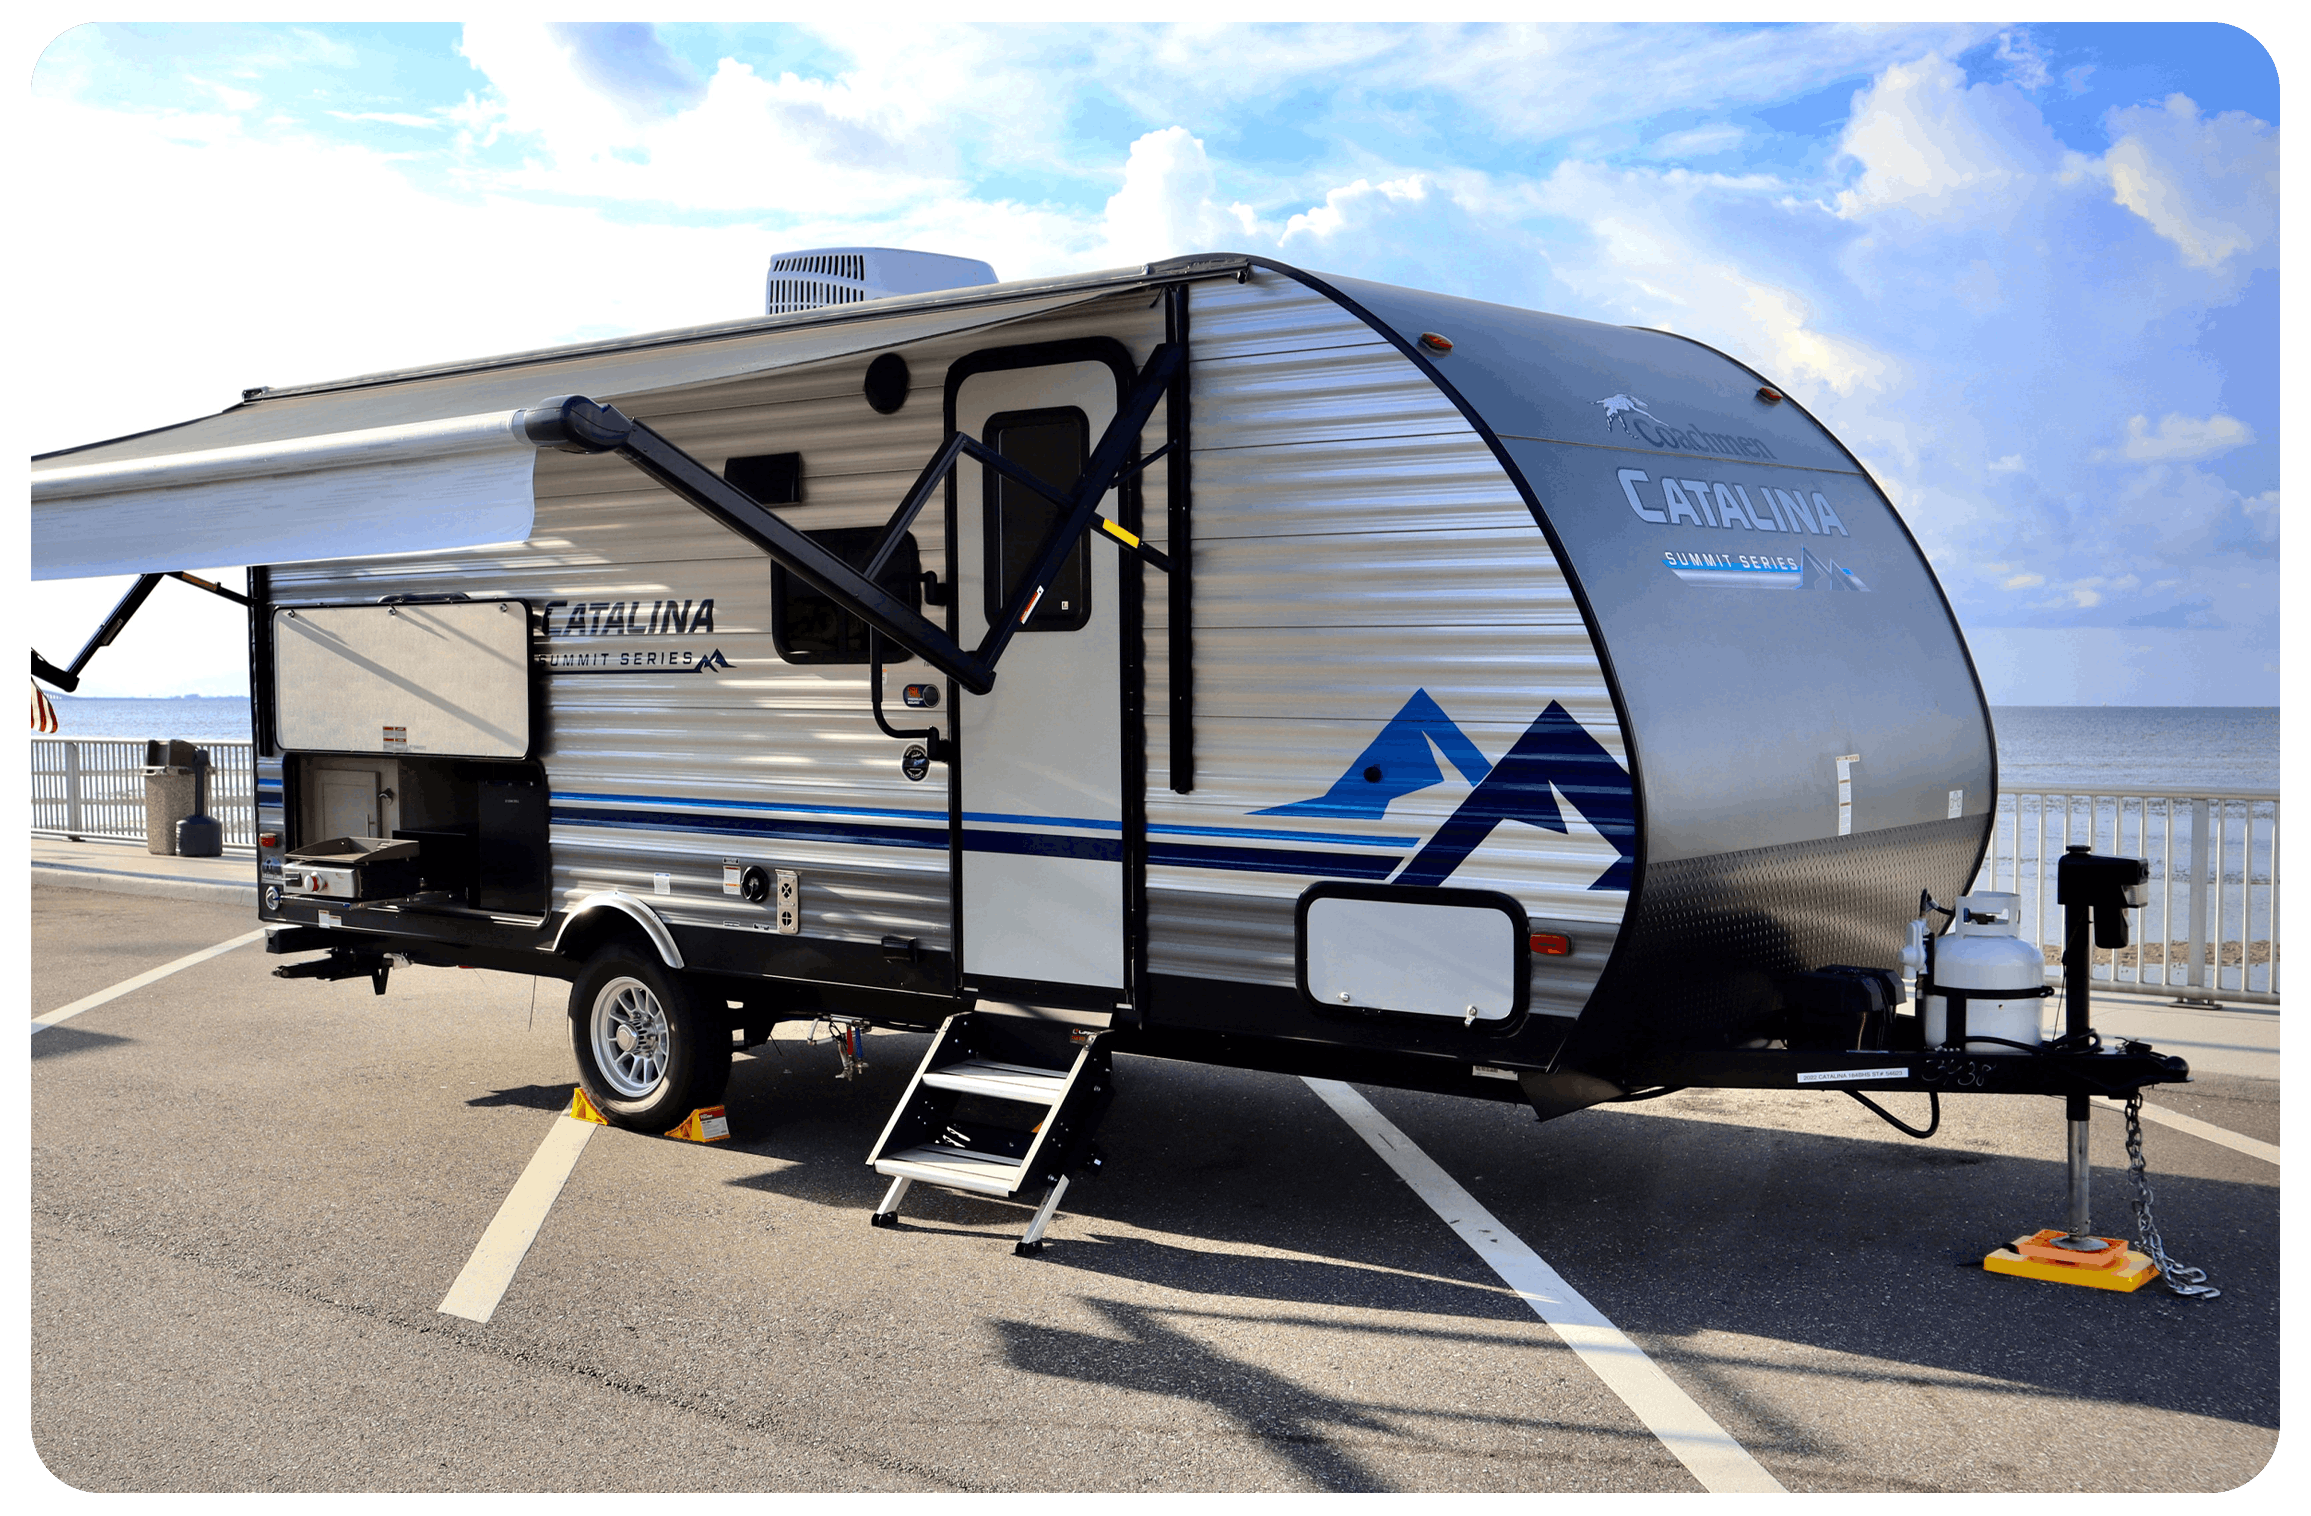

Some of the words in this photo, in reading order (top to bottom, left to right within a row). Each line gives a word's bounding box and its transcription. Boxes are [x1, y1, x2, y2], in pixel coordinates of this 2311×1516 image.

[1633, 418, 1778, 460] Coachmen
[1616, 466, 1850, 537] CATALINA
[1664, 551, 1733, 568] SUMMIT
[1738, 554, 1799, 571] SERIES
[541, 599, 715, 636] CATALINA
[538, 652, 609, 667] SUMMIT
[620, 651, 692, 666] SERIES
